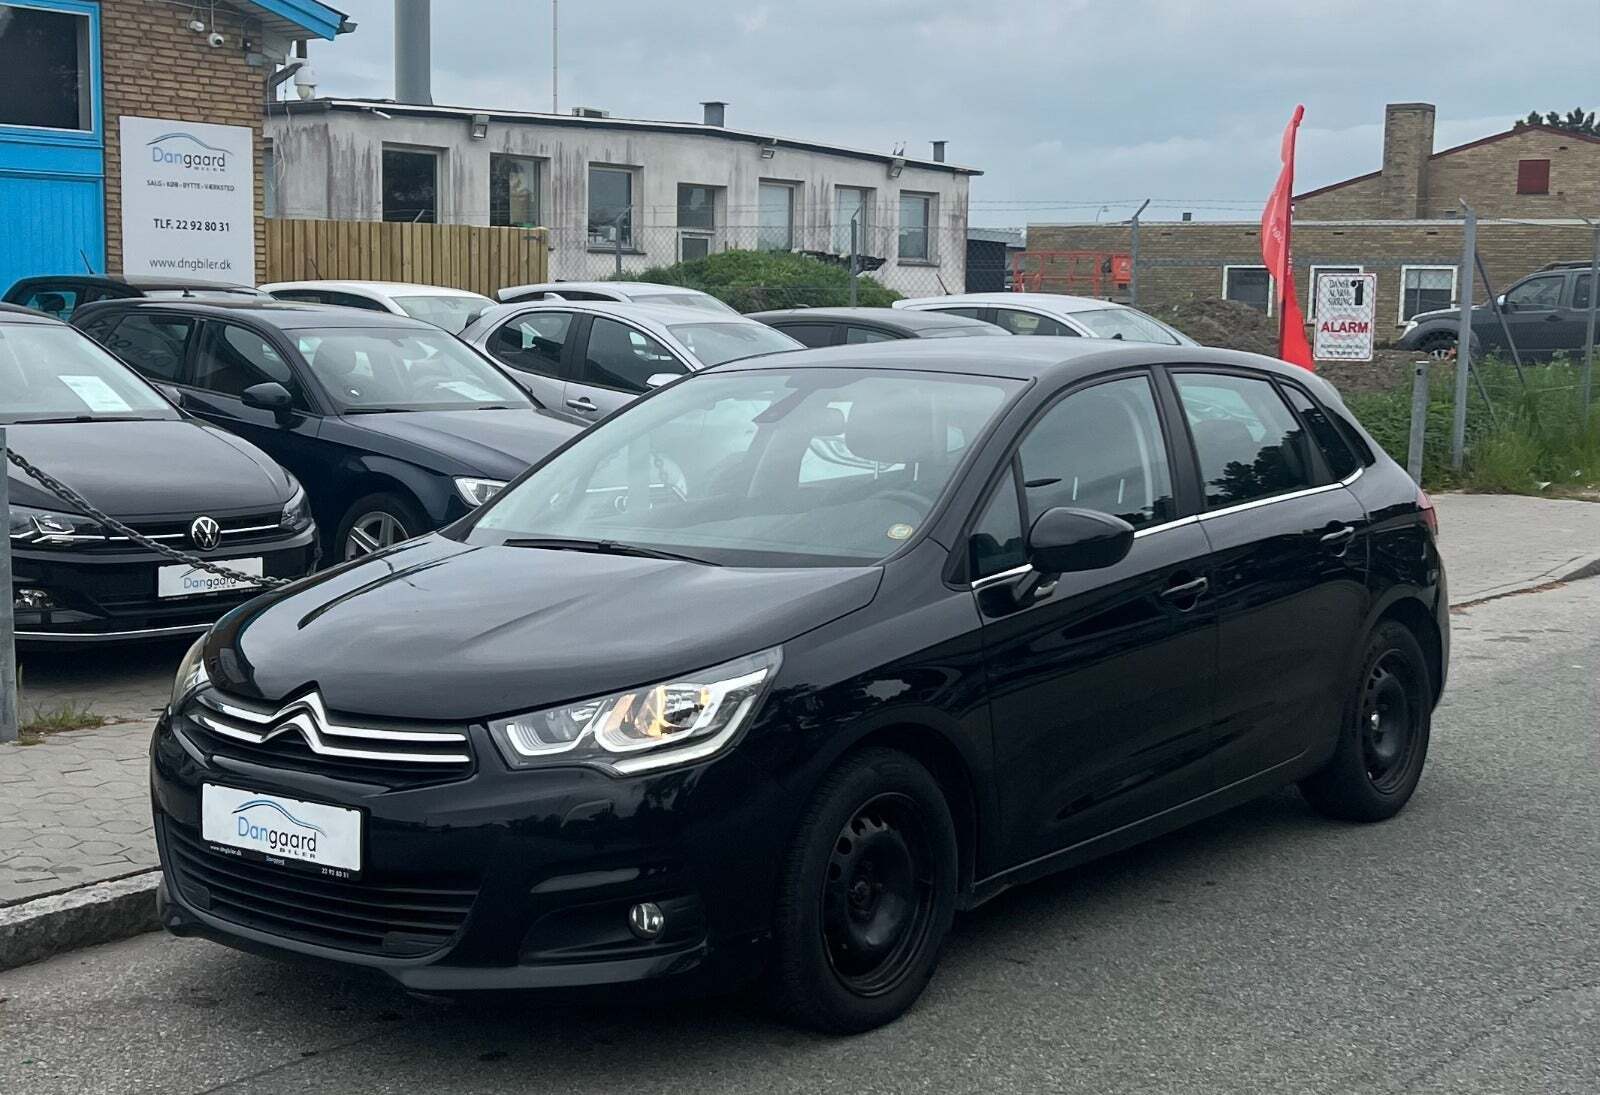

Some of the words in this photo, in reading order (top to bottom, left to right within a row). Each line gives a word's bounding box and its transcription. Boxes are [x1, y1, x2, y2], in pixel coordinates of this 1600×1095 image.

[152, 146, 226, 169] Dangaard
[153, 218, 174, 229] TLF.
[175, 219, 188, 230] 22
[190, 220, 203, 231] 92
[204, 221, 217, 232] 80
[218, 222, 230, 232] 31
[149, 257, 232, 272] www.dngbiler.dk
[1320, 321, 1369, 333] ALARM
[238, 816, 317, 852] Dangaard
[279, 847, 317, 859] BILER
